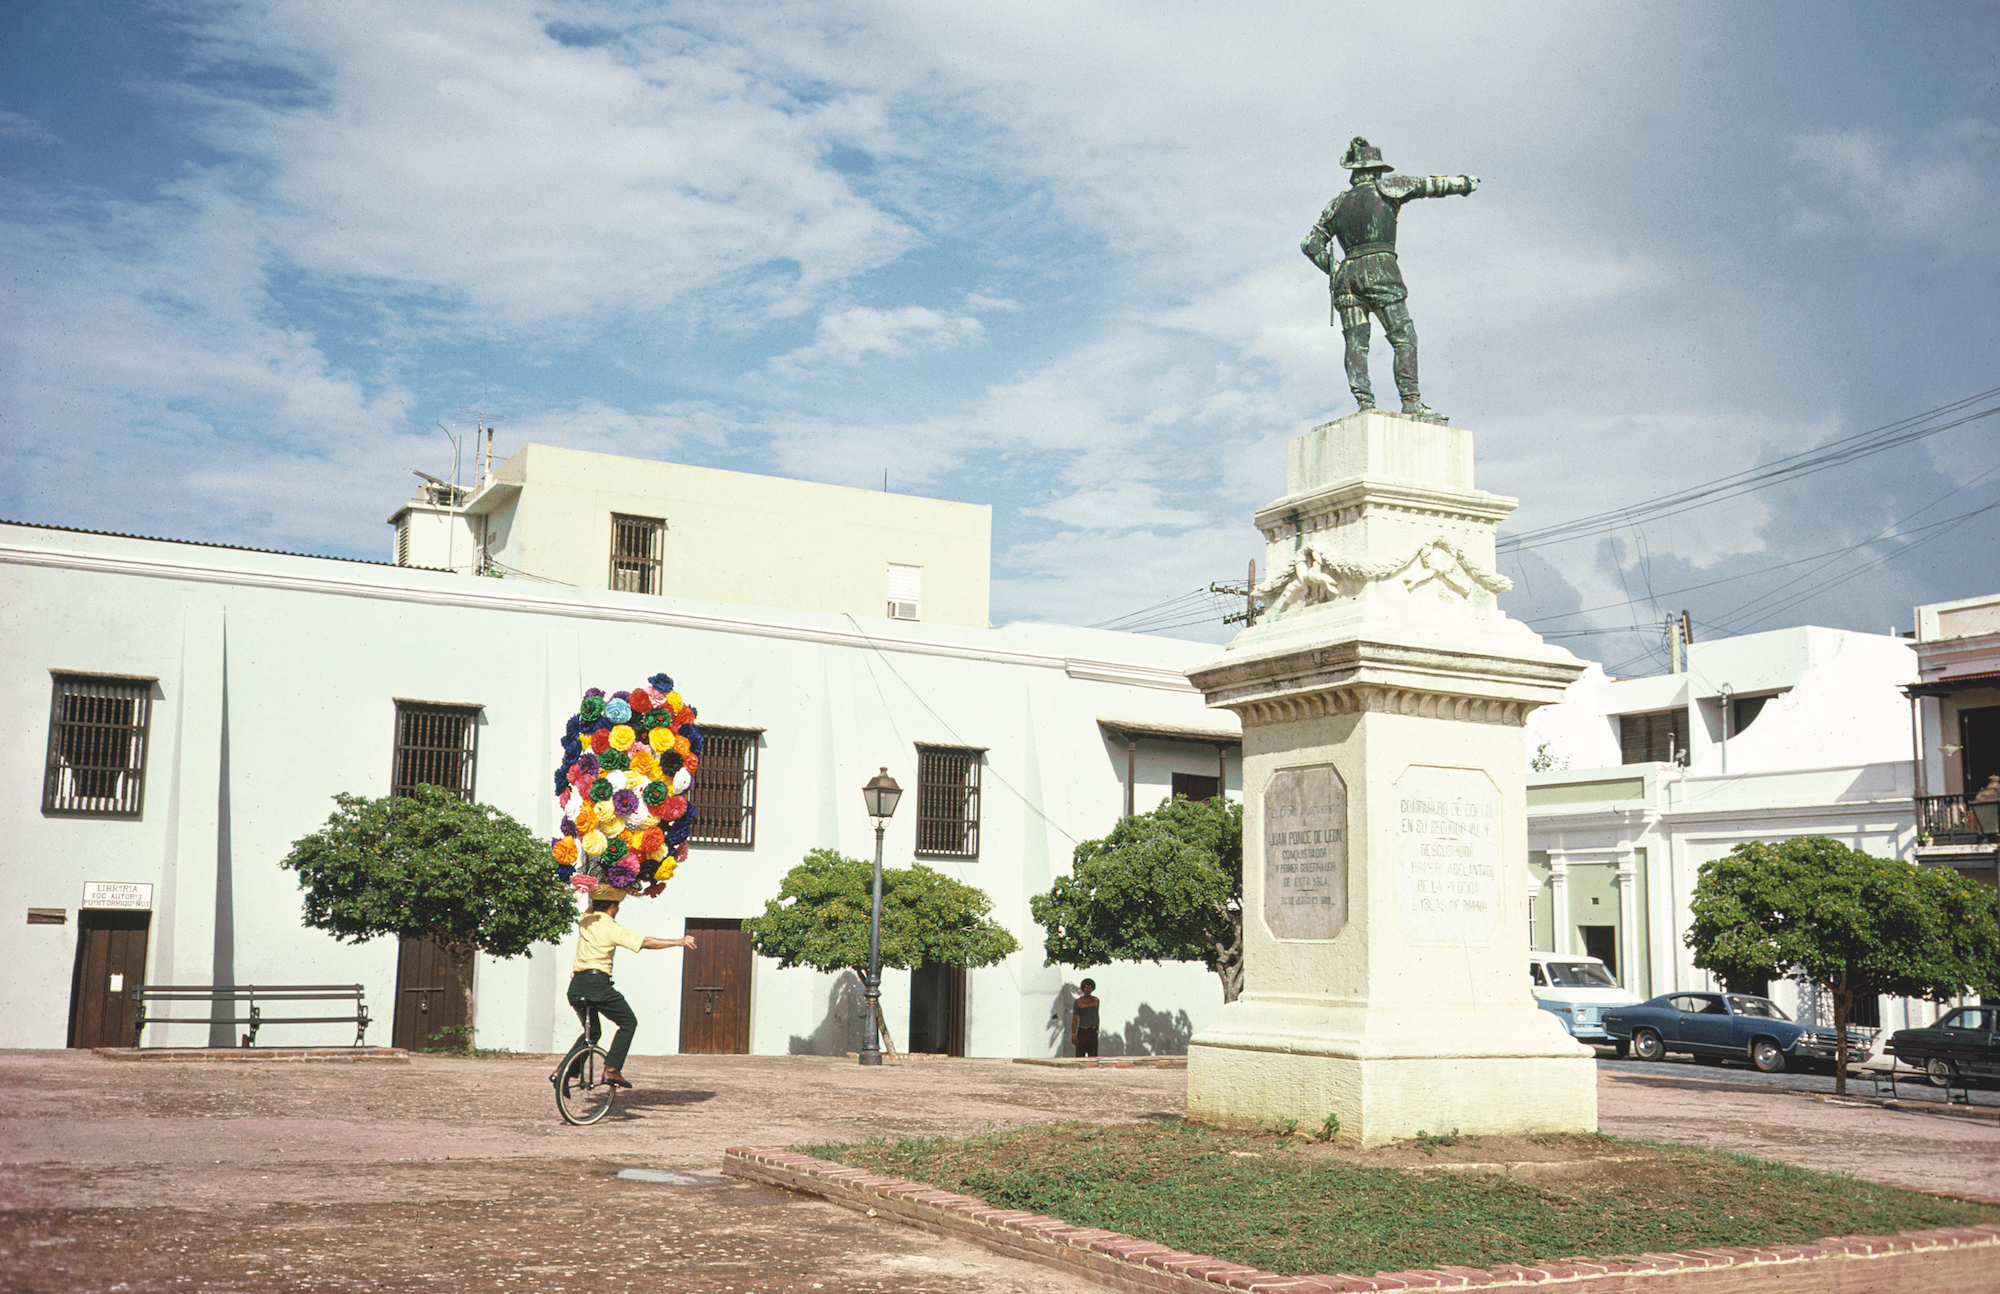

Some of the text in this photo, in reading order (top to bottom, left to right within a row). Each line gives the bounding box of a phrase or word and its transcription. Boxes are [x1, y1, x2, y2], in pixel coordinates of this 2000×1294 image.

[1402, 818, 1413, 833] EN
[1416, 819, 1427, 834] SU
[1269, 828, 1342, 846] JUAN PONCE DE LEON
[1282, 848, 1327, 861] CONQUISTADOR
[1283, 877, 1290, 887] DE
[1294, 877, 1310, 887] ESTA
[1418, 879, 1428, 893] DE
[1431, 880, 1442, 893] LA
